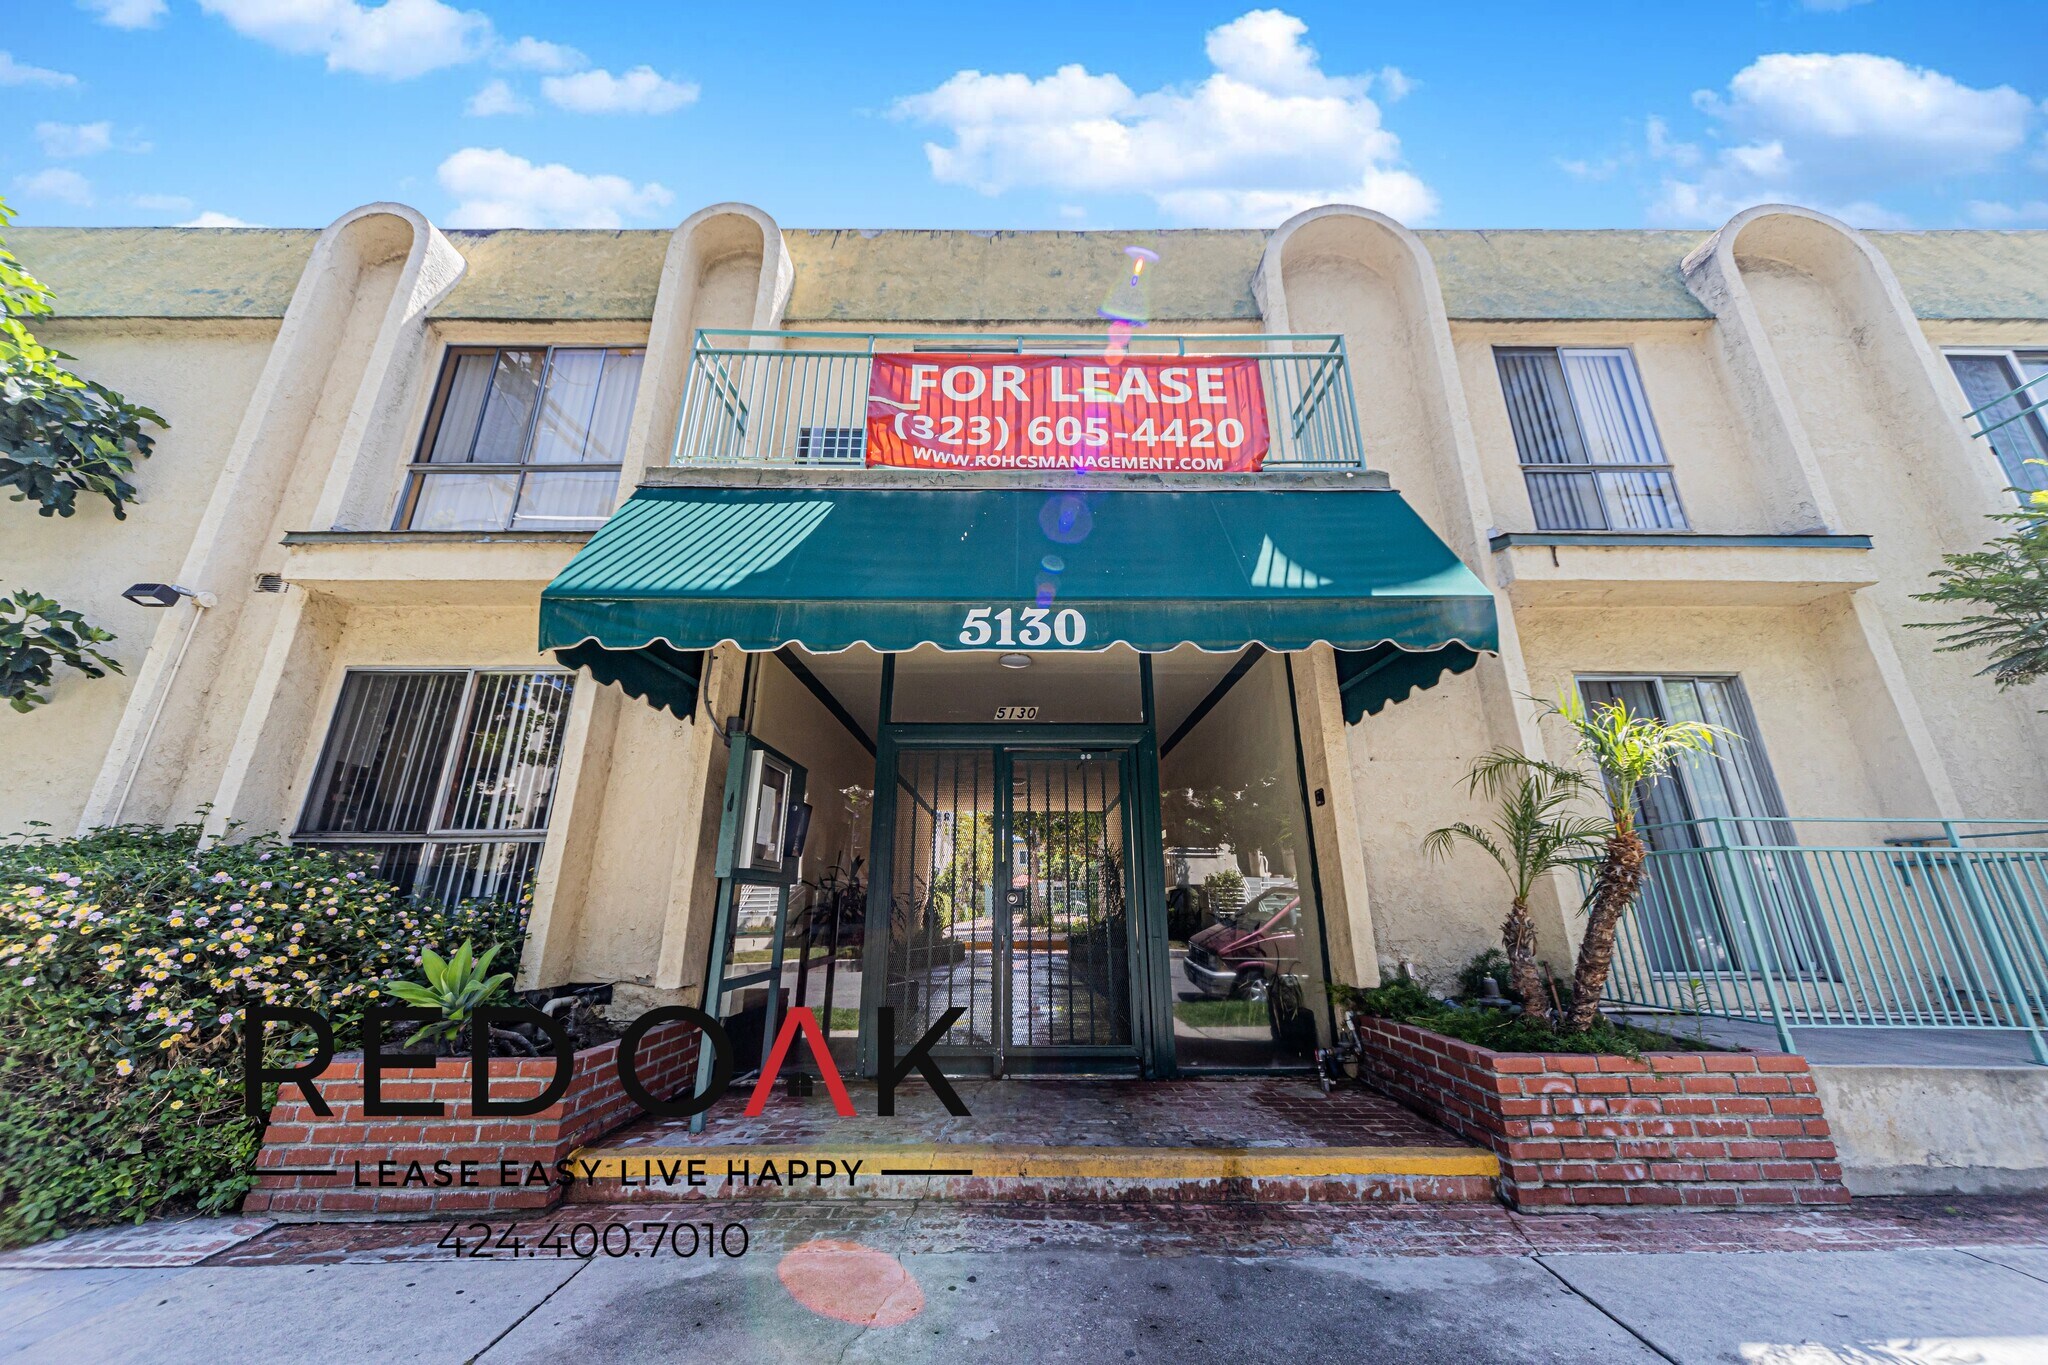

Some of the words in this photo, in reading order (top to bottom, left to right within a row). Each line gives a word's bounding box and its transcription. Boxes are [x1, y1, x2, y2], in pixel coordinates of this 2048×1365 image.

[910, 364, 1031, 402] FOR
[1050, 366, 1228, 404] LEASE
[894, 411, 1009, 451] (323)
[1027, 415, 1245, 448] 605-4420
[912, 445, 1224, 471] WWW.ROHCSMANAGEMENT.COM
[958, 606, 1087, 646] 5130
[996, 707, 1037, 719] 5130
